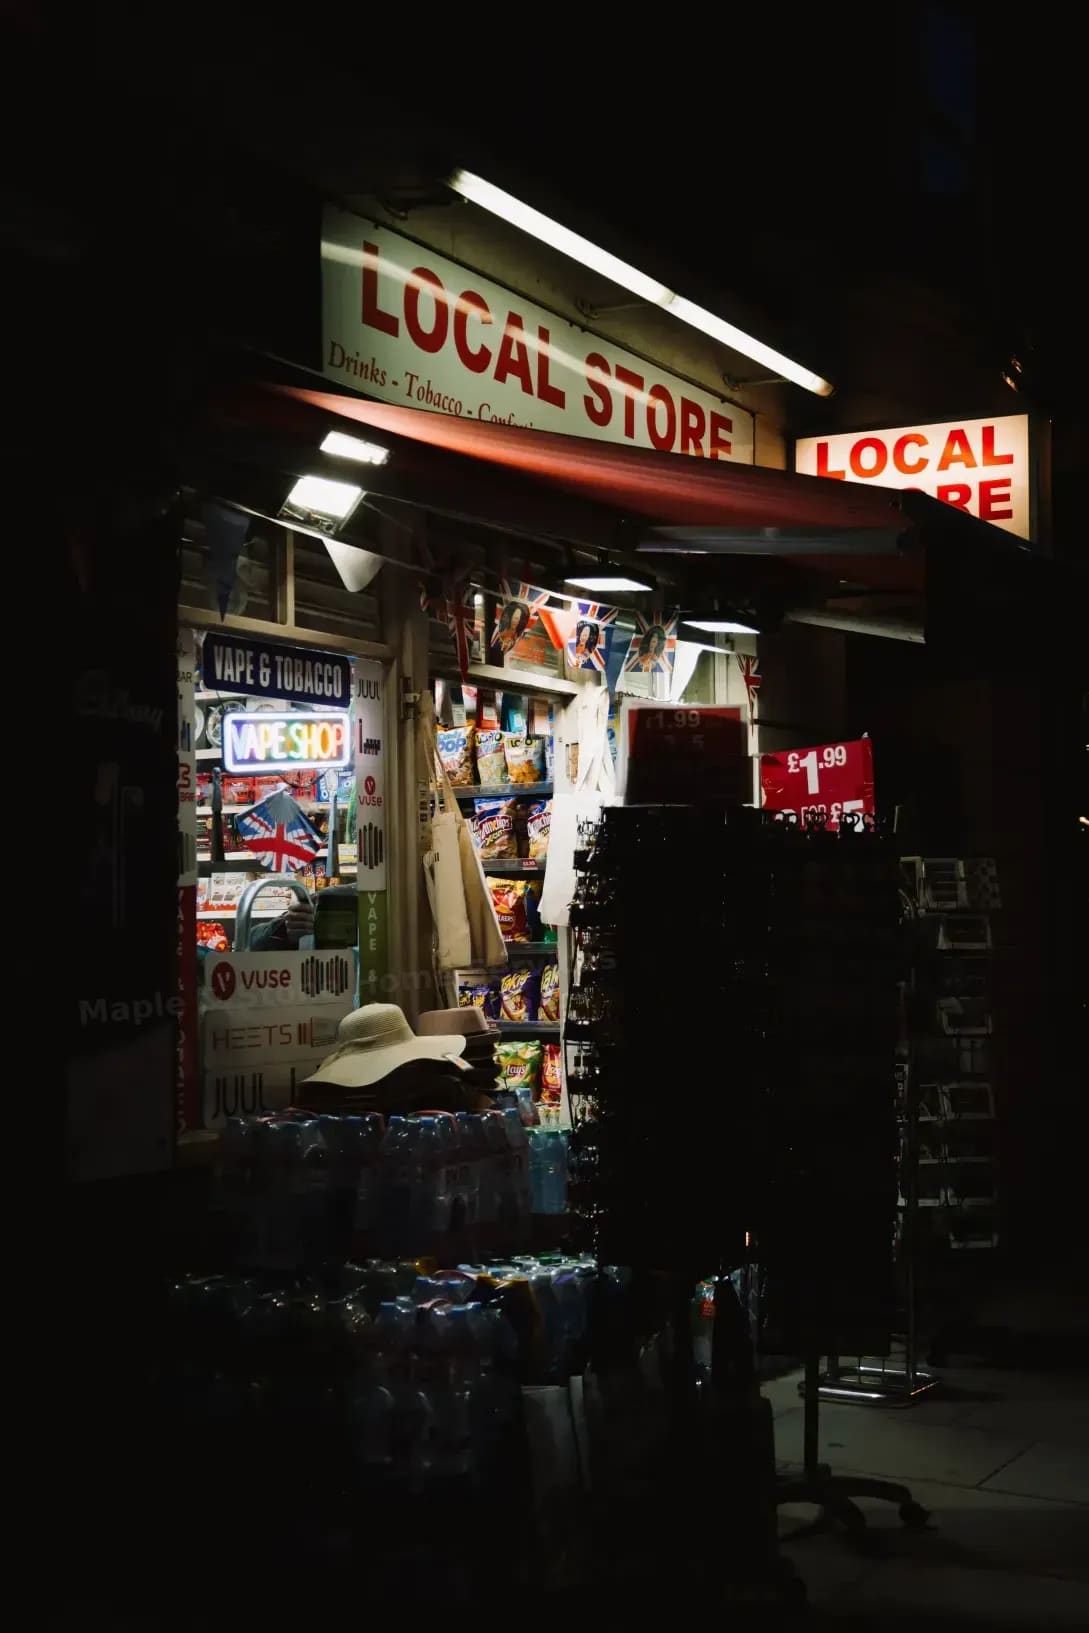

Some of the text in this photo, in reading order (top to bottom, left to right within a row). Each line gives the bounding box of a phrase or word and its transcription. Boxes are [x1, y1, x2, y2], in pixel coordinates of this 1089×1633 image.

[361, 239, 733, 460] LOCAL STORE
[328, 341, 387, 387] Drinks
[405, 372, 462, 417] Tobacco
[478, 403, 533, 427] Conf
[816, 425, 1014, 481] LOCAL
[903, 478, 1013, 521] RE
[213, 645, 342, 699] VAPE & TOBACCO
[357, 679, 381, 698] JUUL
[230, 720, 343, 762] VAPE SHOP
[787, 745, 847, 795] £1.99
[367, 892, 377, 951] VAPE
[240, 969, 291, 990] vuse
[211, 1072, 268, 1122] JUUL
